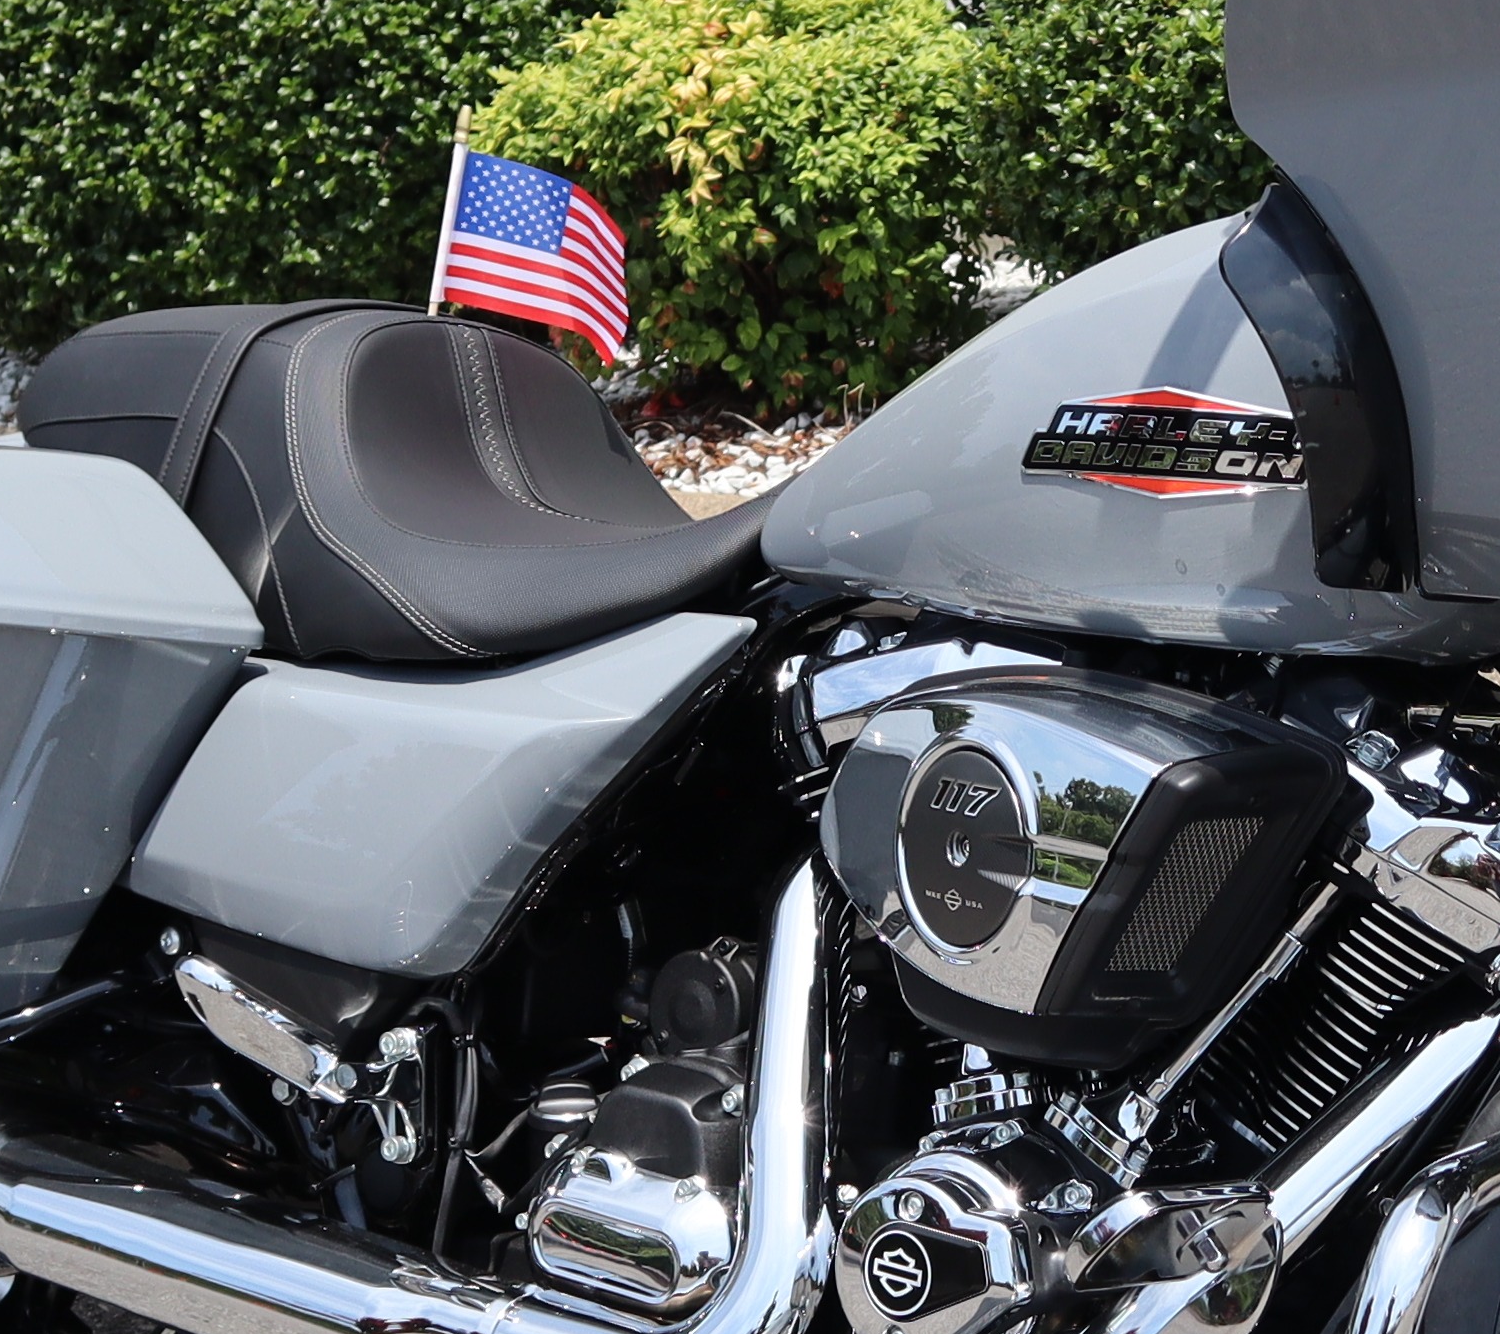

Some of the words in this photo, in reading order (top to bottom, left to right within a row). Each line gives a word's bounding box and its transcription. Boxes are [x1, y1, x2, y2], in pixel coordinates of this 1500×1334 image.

[1031, 439, 1304, 479] DAVIDSON
[930, 777, 1002, 816] 117
[965, 899, 983, 910] USA
